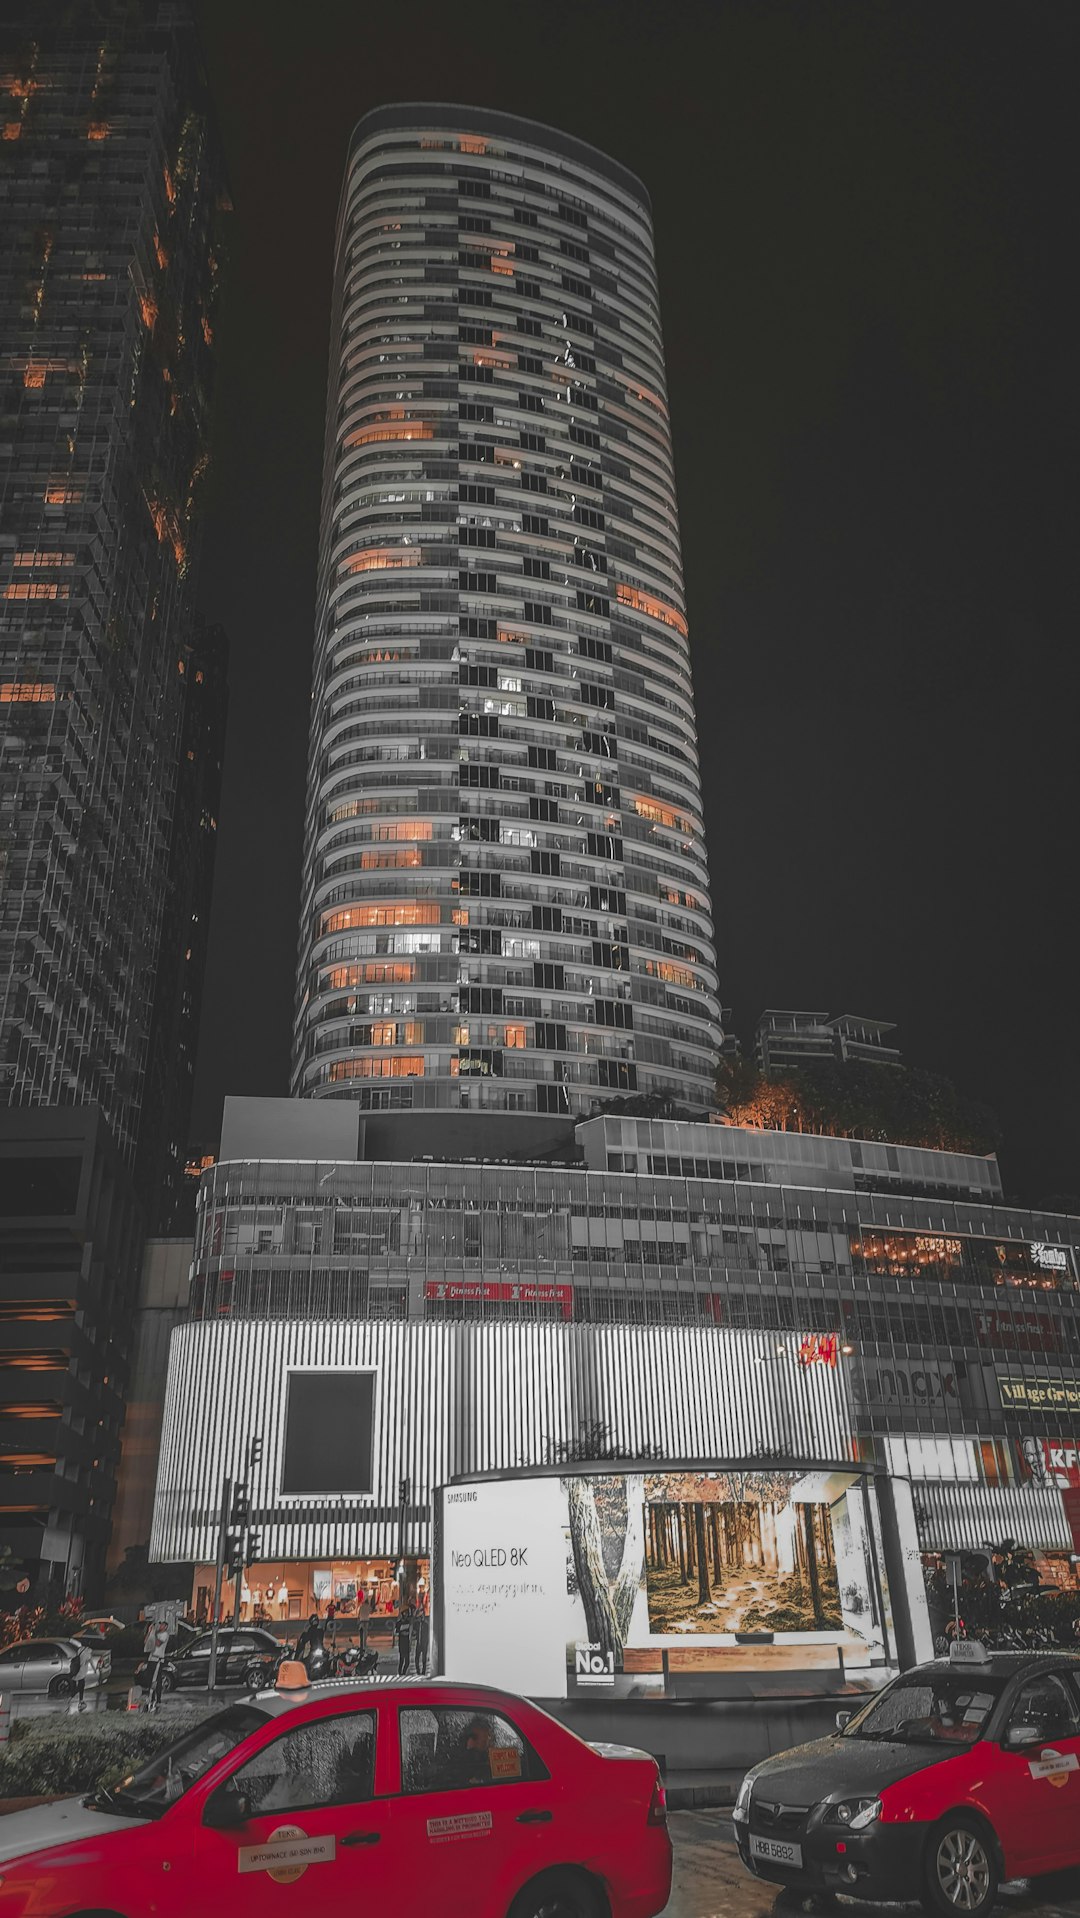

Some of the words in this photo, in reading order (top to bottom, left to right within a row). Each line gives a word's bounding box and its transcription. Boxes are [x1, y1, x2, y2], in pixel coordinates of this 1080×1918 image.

[475, 1286, 490, 1296] Fist
[876, 1368, 959, 1398] max
[879, 1397, 936, 1405] AHION
[1002, 1384, 1046, 1403] Village
[1050, 1448, 1080, 1468] KF
[447, 1491, 478, 1504] SAMSUNG
[451, 1549, 472, 1568] Neo
[473, 1548, 507, 1568] QLED
[509, 1547, 529, 1567] 8K
[575, 1650, 615, 1674] No.1
